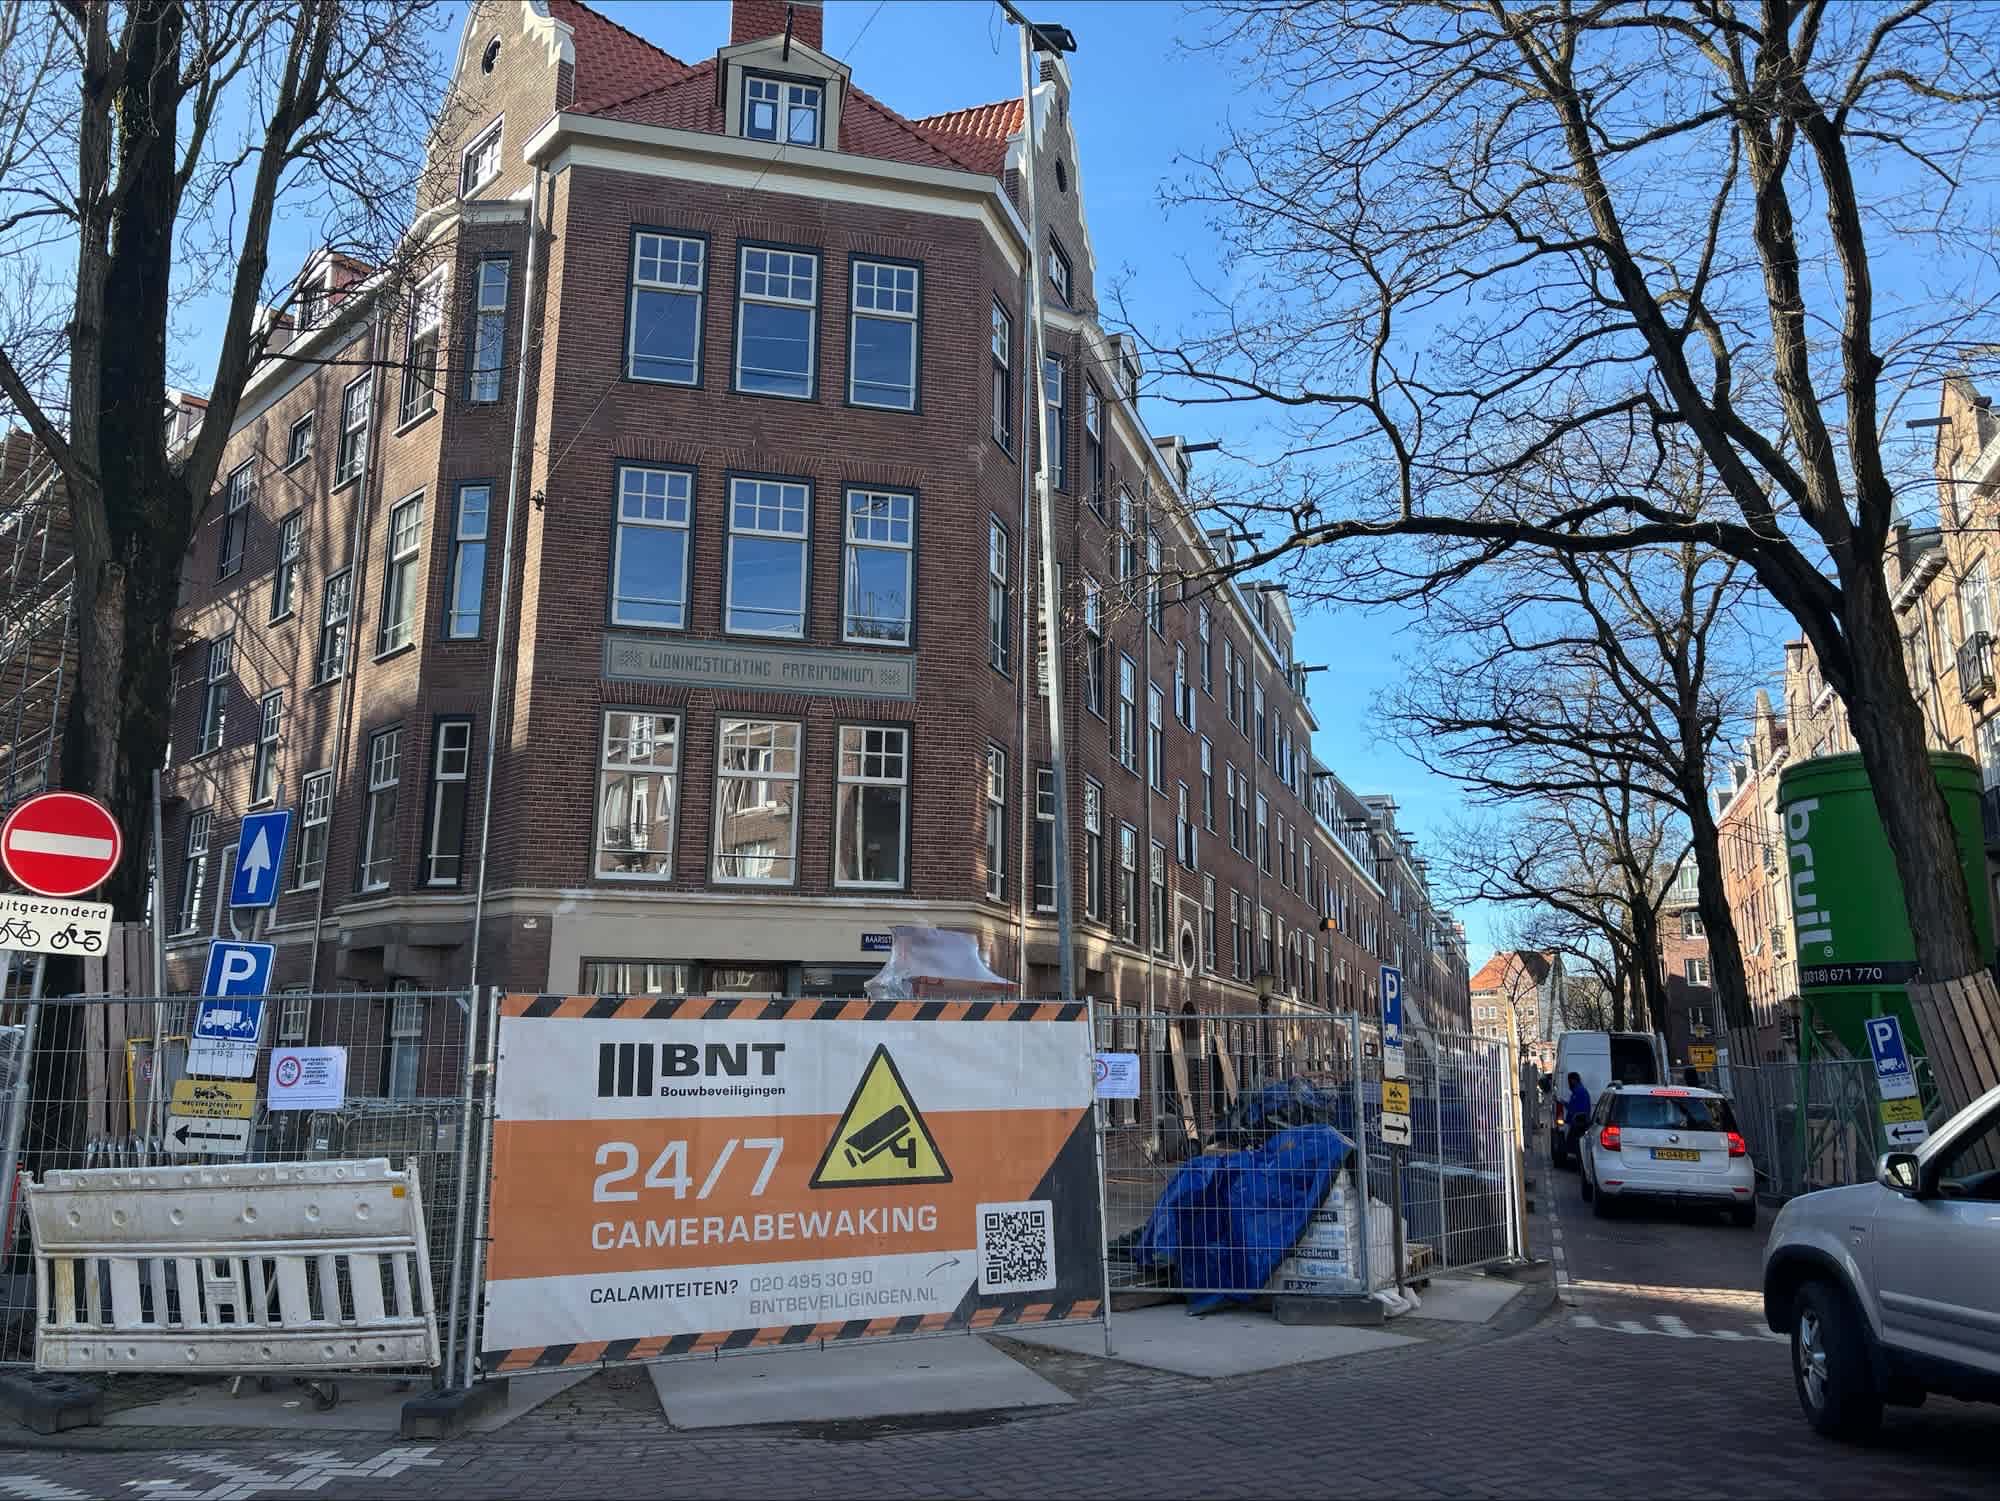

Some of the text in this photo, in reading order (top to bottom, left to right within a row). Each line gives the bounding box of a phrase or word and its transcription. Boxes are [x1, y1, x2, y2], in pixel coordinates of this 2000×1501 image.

[649, 652, 874, 684] WONINGSTICHTING PATRIMONIUM
[1787, 799, 1833, 950] bruil
[1830, 968, 1851, 982] 671
[1855, 966, 1882, 980] 770
[661, 1043, 786, 1077] BNT
[660, 1086, 786, 1098] Bouwbeveiligingen
[593, 1136, 785, 1202] 24/7
[591, 1205, 938, 1250] CAMERABEWAKING
[590, 1270, 873, 1304] CALAMITEITEN? 020 495 30 90
[750, 1287, 938, 1315] BNTBEVEILIGINGEN.NL
